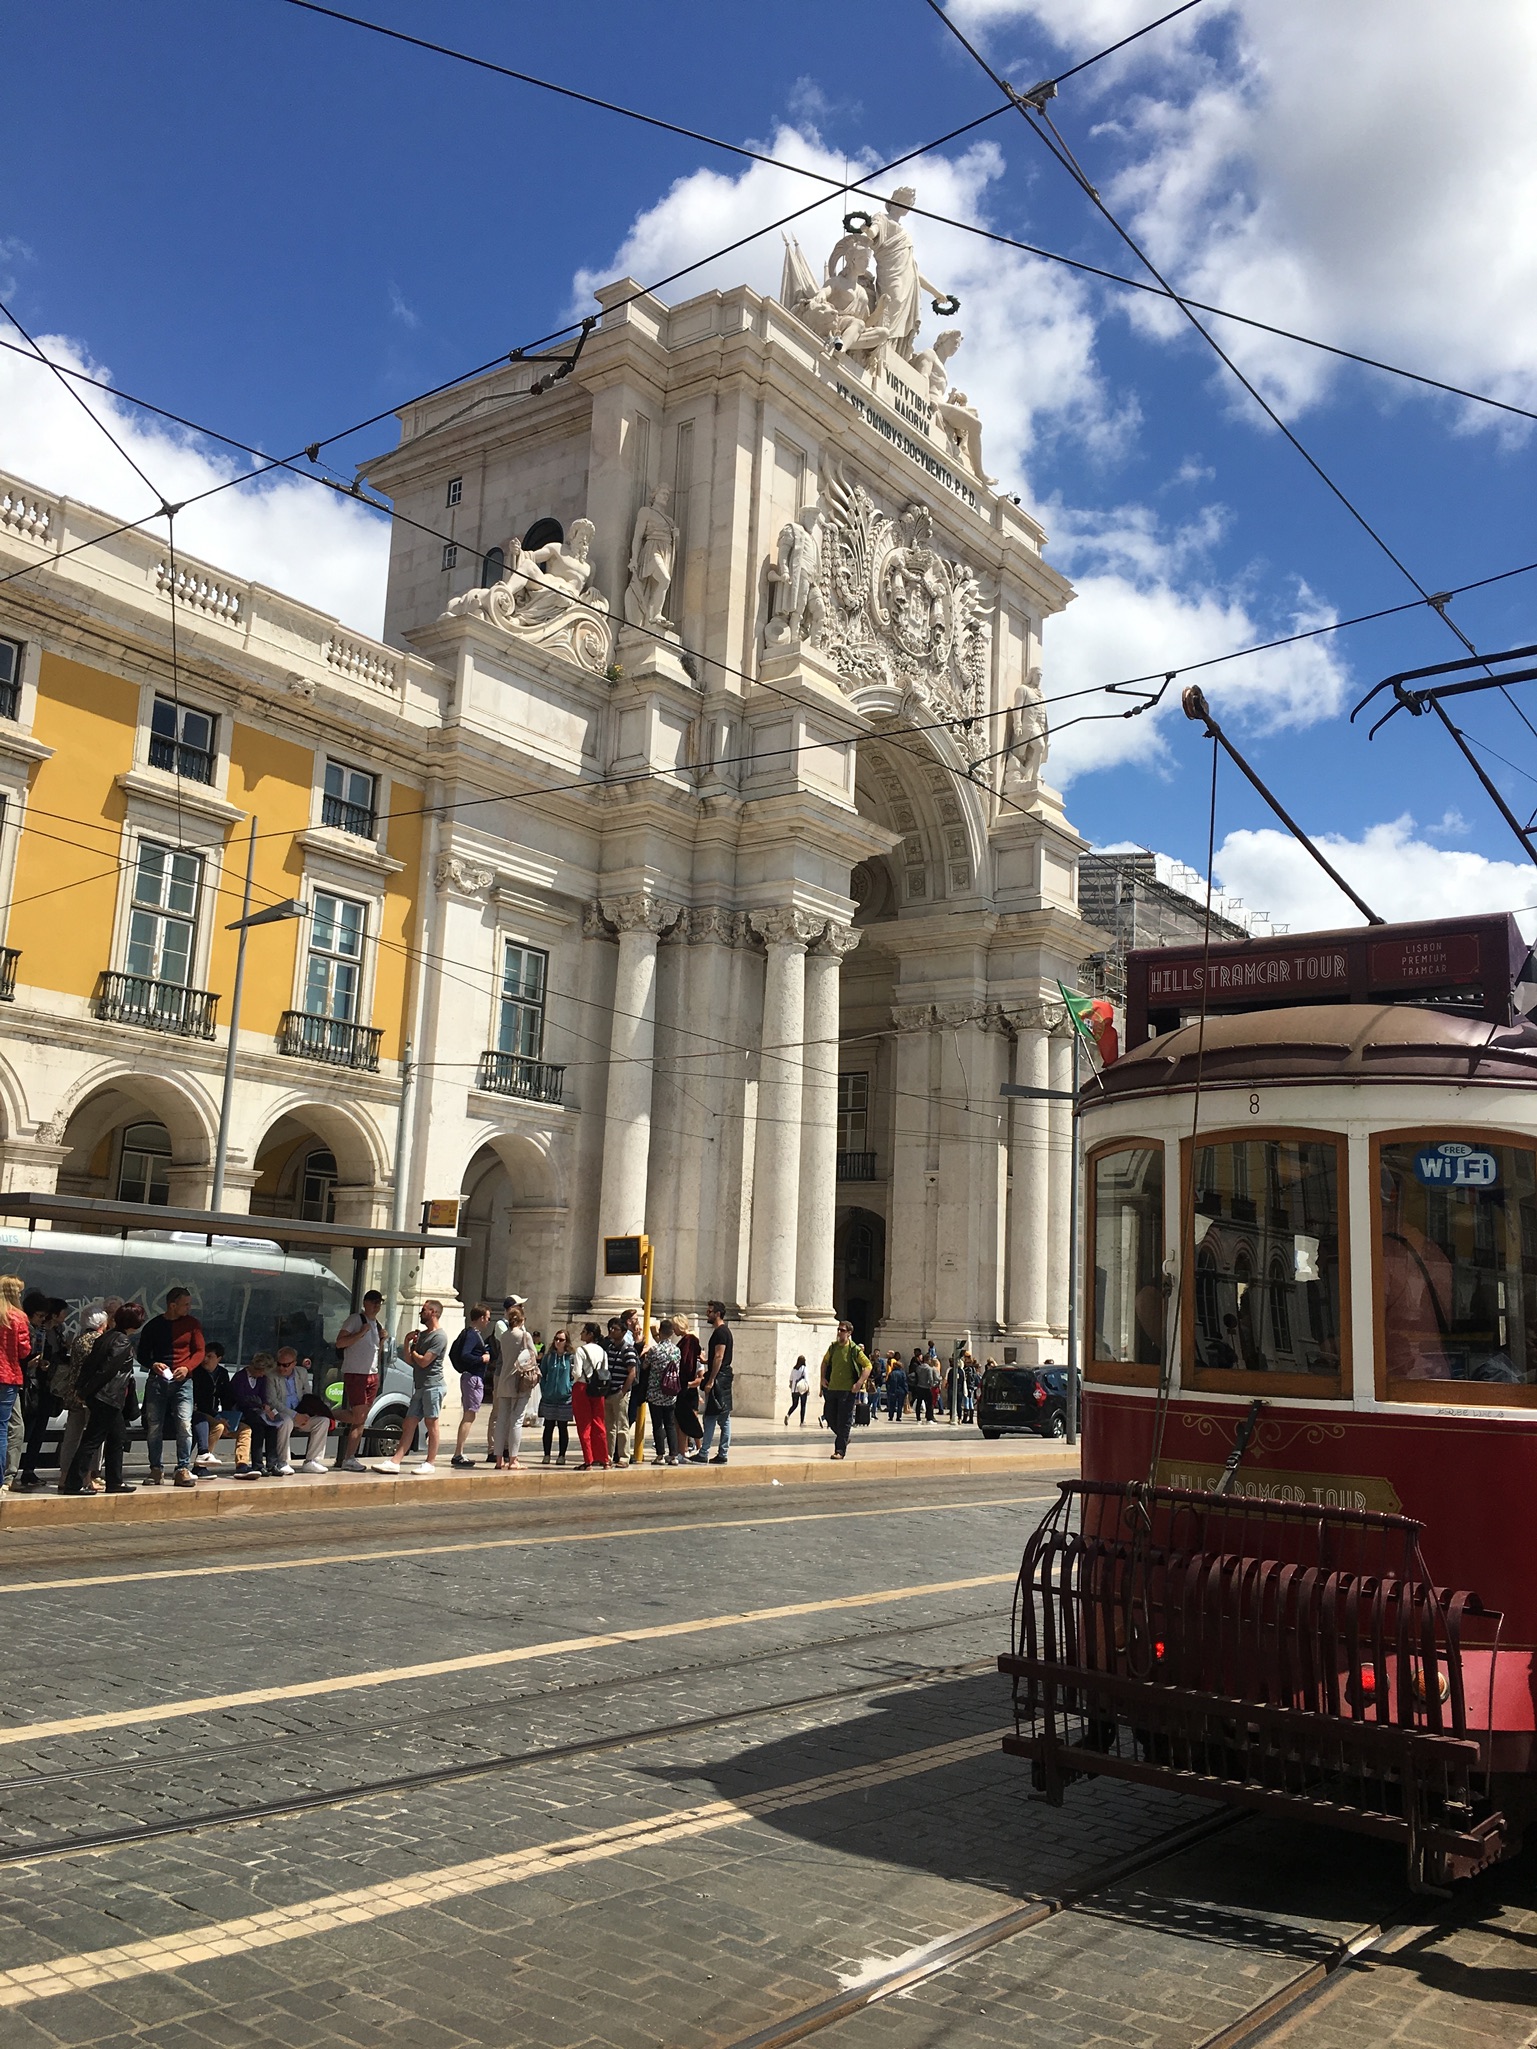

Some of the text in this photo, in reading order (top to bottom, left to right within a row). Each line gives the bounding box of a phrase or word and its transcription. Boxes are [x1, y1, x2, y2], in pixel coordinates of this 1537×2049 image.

[836, 381, 850, 400] VT
[885, 368, 932, 420] VIRTVTIBVS
[894, 396, 930, 437] MAIORVM
[1405, 943, 1442, 954] LISBON
[1401, 953, 1447, 965] PREMIUM
[1151, 954, 1346, 993] HILLS TRAMCAR TOUR
[1402, 964, 1447, 976] TRAMCAR
[1249, 1093, 1260, 1115] 8
[1444, 1146, 1466, 1154] FREE
[0, 1234, 19, 1244] urs
[1233, 1480, 1306, 1503] RAMCAR
[1312, 1487, 1367, 1515] TOUR
